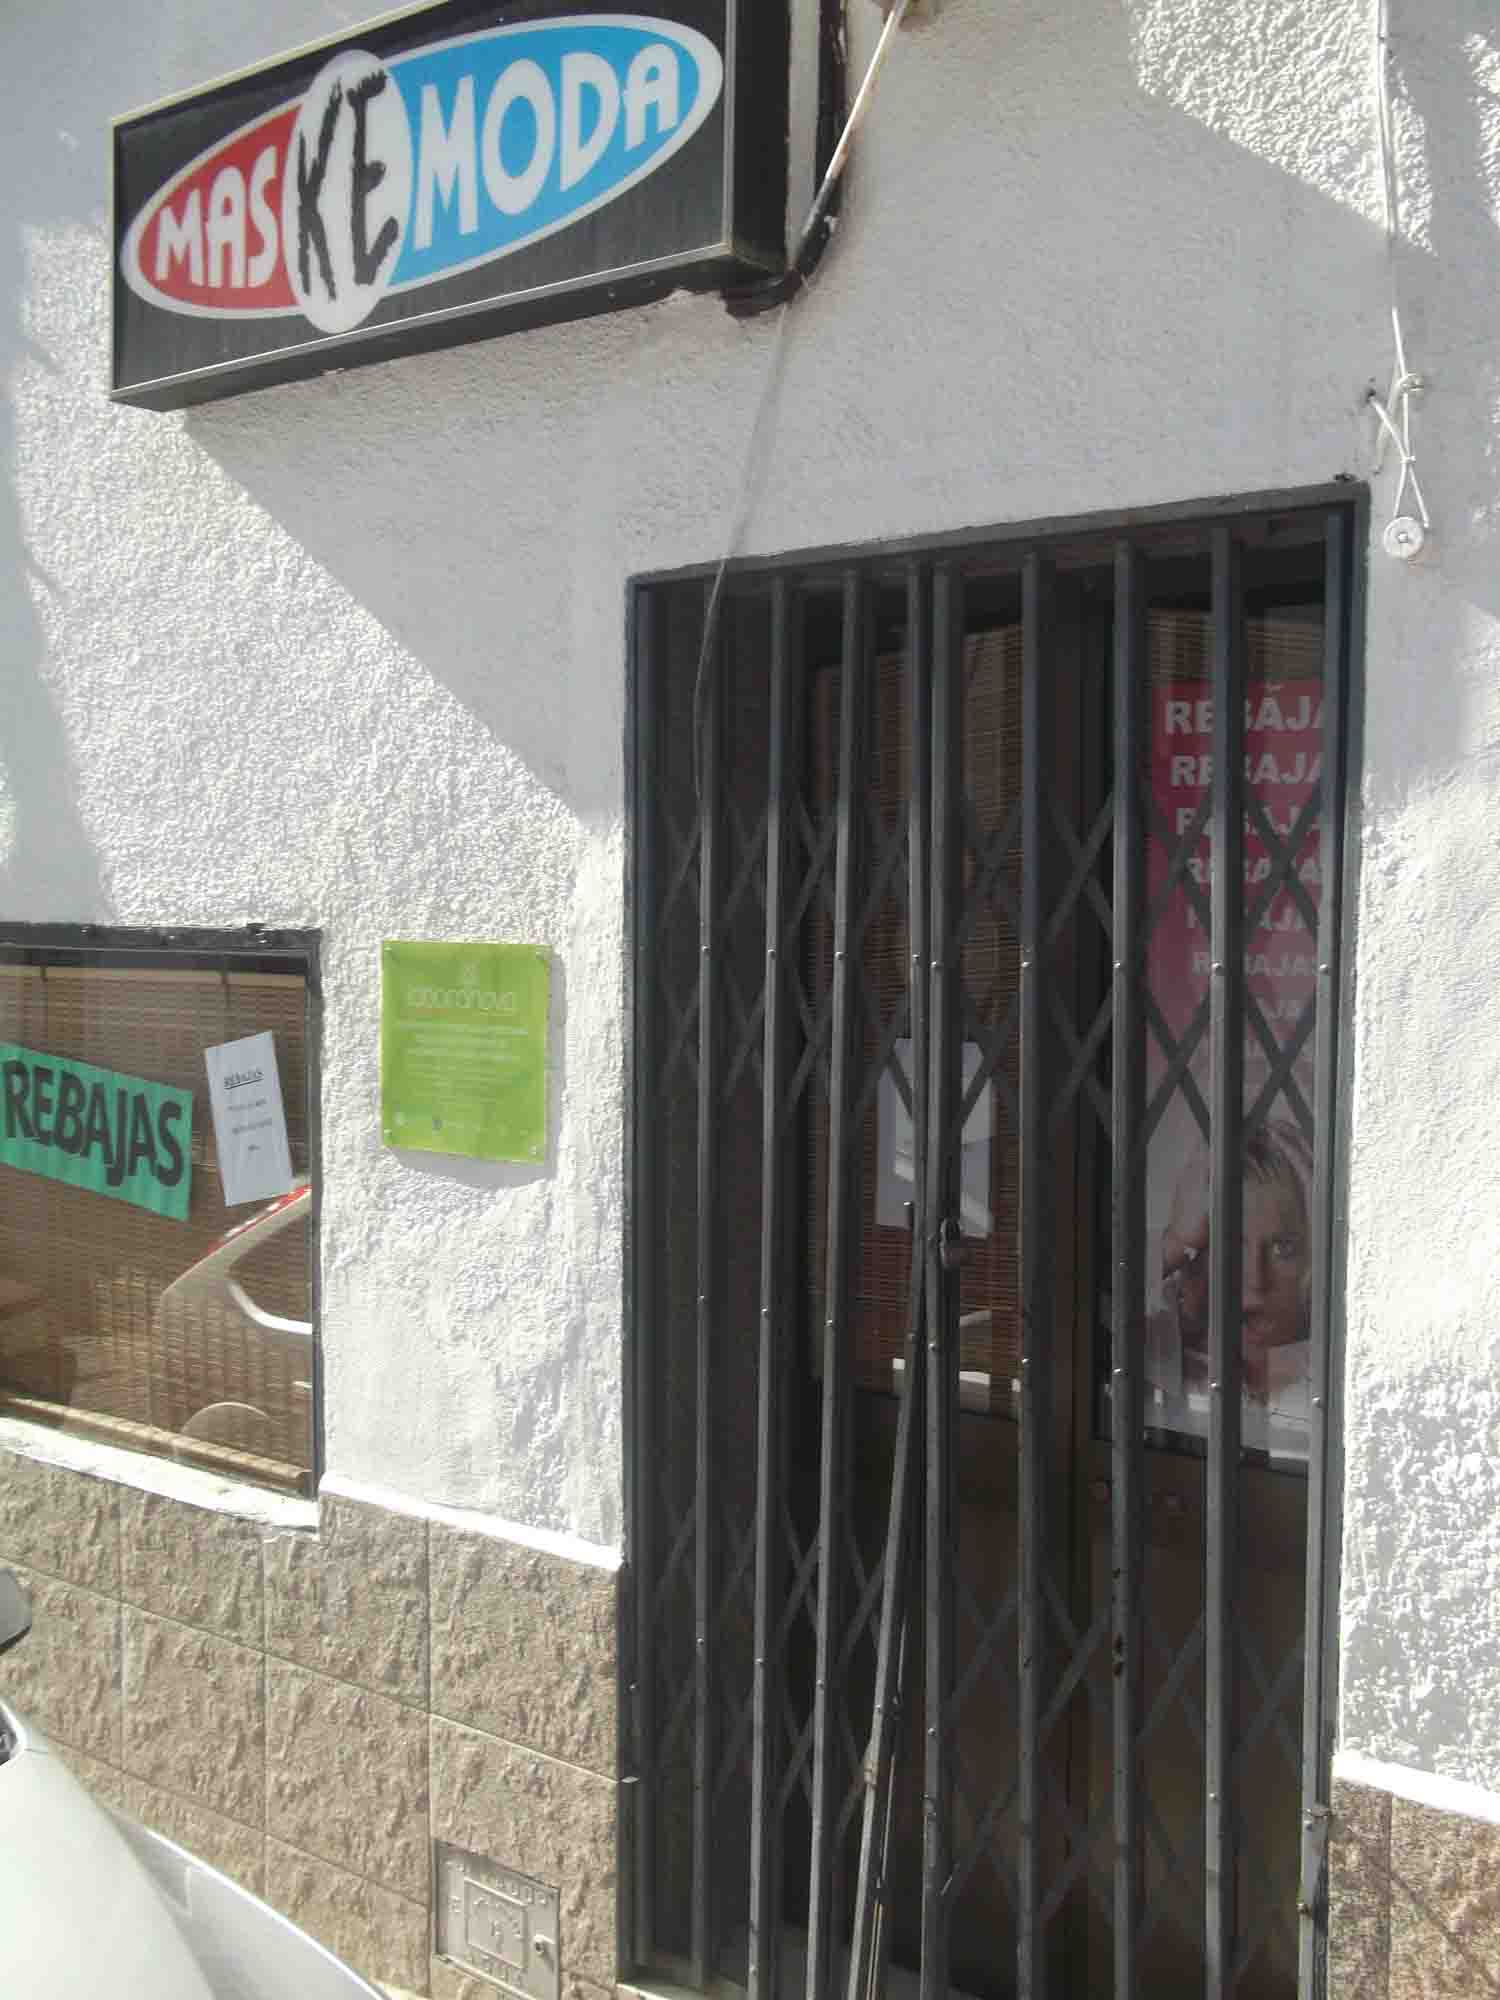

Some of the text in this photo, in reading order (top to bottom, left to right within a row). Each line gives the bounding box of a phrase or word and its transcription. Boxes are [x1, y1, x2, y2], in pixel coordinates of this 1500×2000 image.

[156, 42, 679, 304] MAS KE MODA
[1, 1059, 183, 1187] REBAJAS
